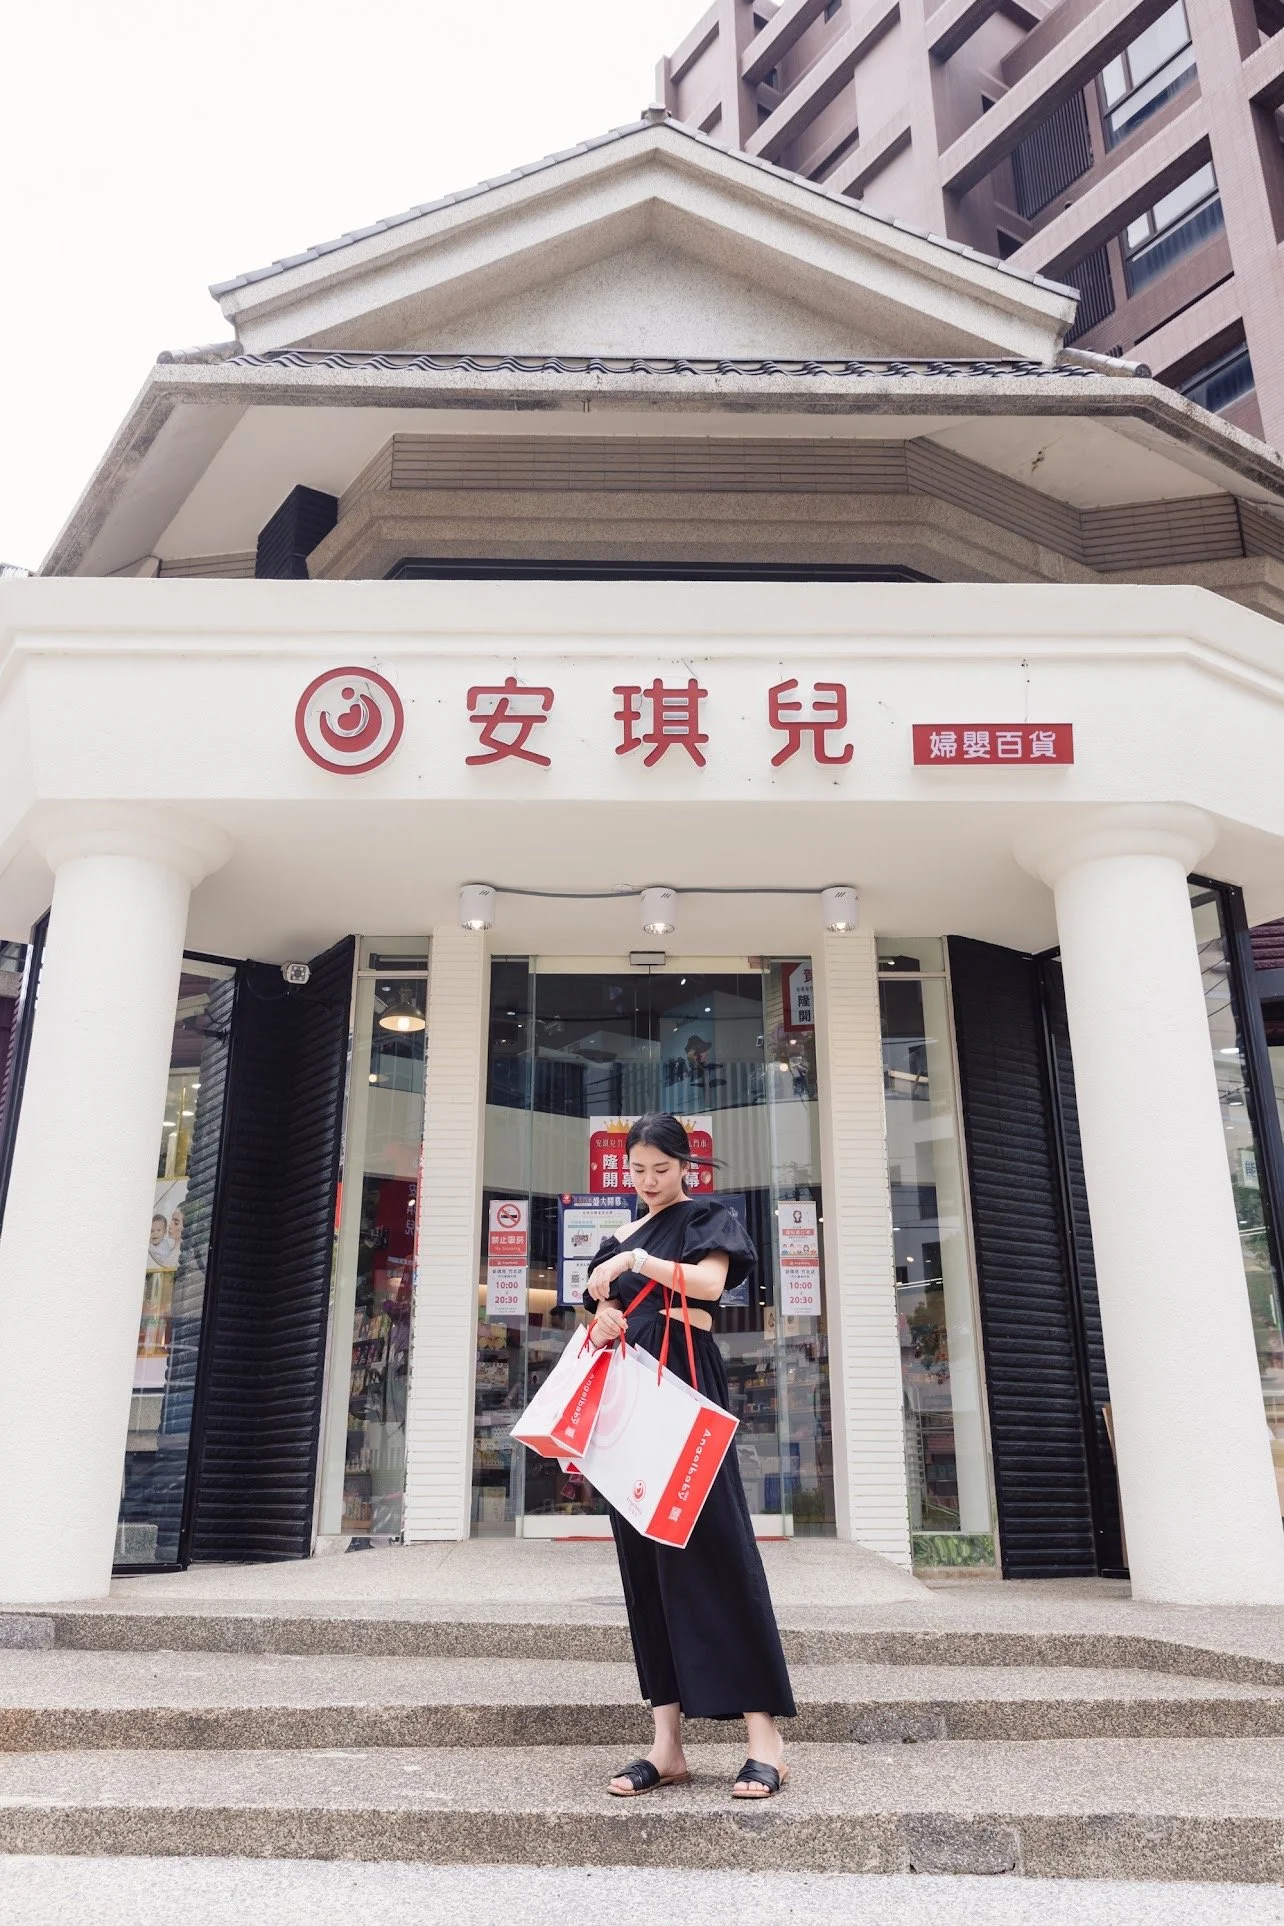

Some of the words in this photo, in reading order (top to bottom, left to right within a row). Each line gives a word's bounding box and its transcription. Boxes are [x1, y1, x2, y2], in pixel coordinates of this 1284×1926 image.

[465, 676, 855, 768] 安琪兒
[929, 730, 1057, 759] 婦嬰百貨
[496, 1281, 518, 1289] 10:00
[789, 1281, 812, 1289] 10:00
[495, 1296, 518, 1304] 20:30
[789, 1296, 813, 1304] 20:30
